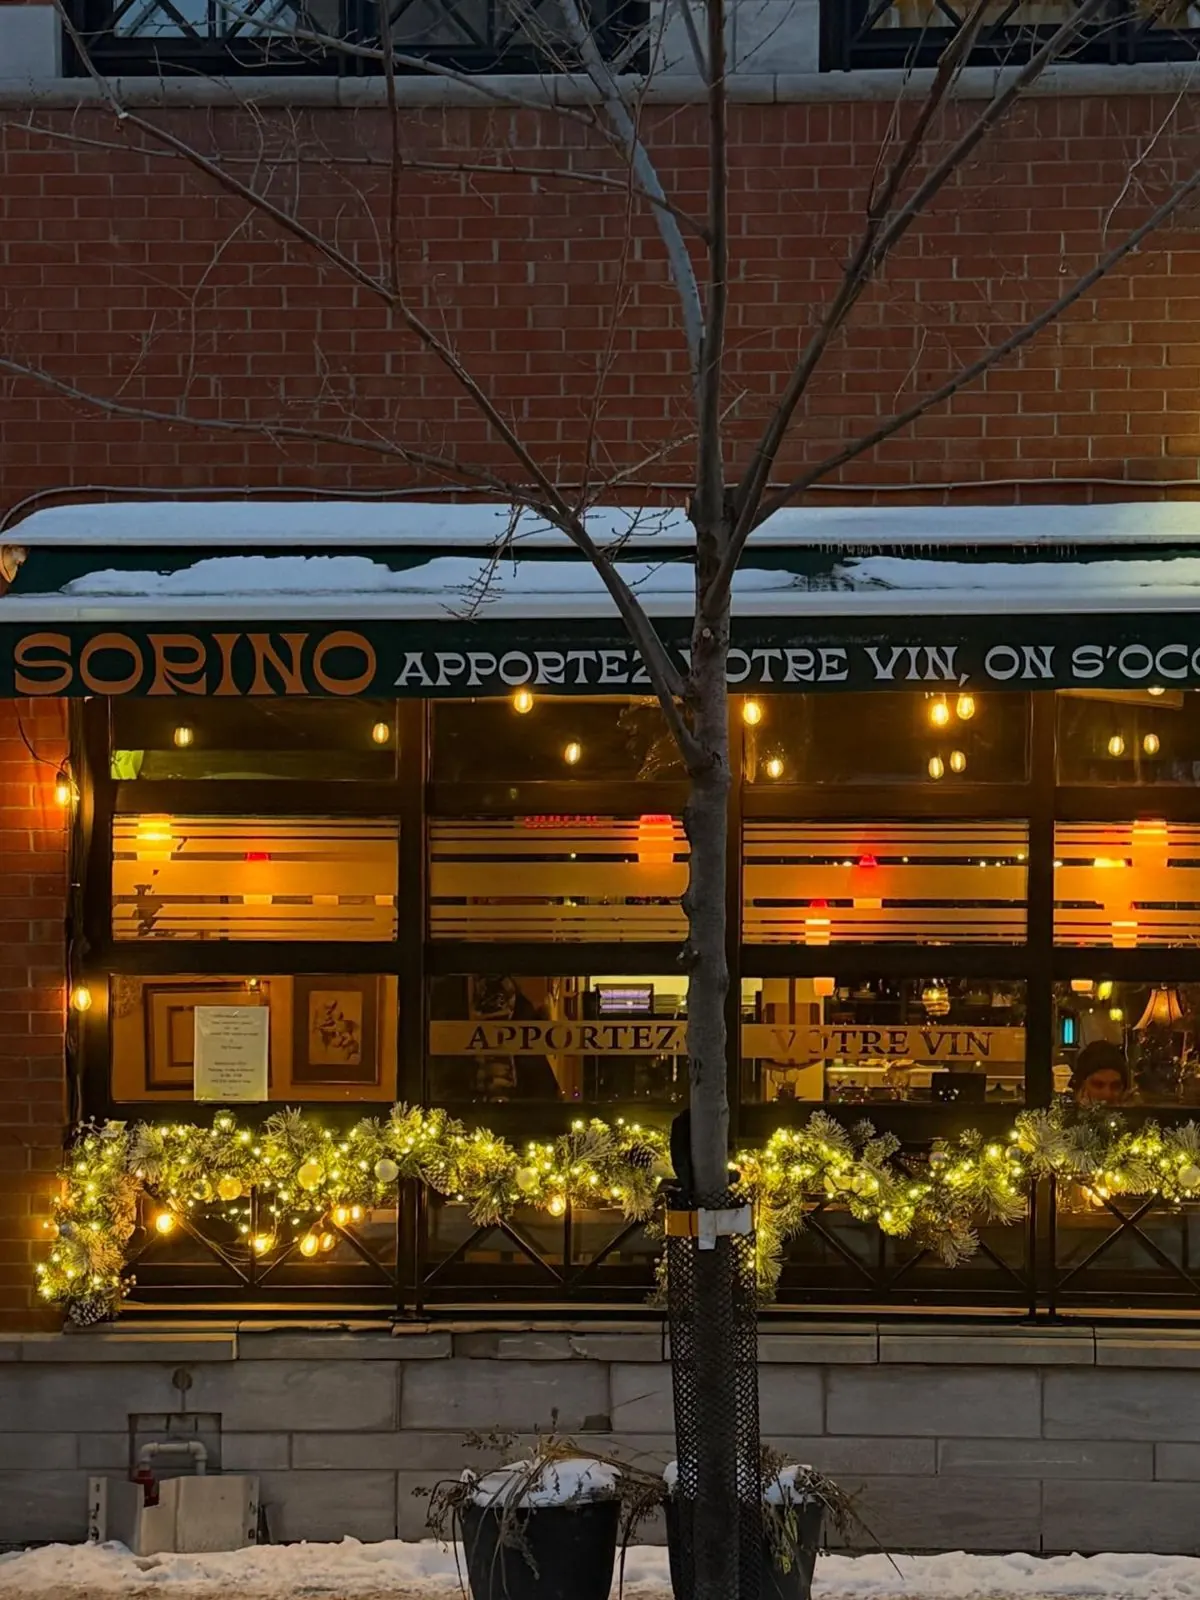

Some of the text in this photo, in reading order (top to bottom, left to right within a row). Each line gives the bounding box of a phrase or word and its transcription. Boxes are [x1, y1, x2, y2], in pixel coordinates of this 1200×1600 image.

[14, 631, 377, 696] SORINO
[864, 646, 971, 688] VIN,
[984, 645, 1056, 680] ON
[1071, 643, 1200, 679] S'OC
[465, 1025, 681, 1050] APPORTEZ
[920, 1031, 994, 1057] VIN
